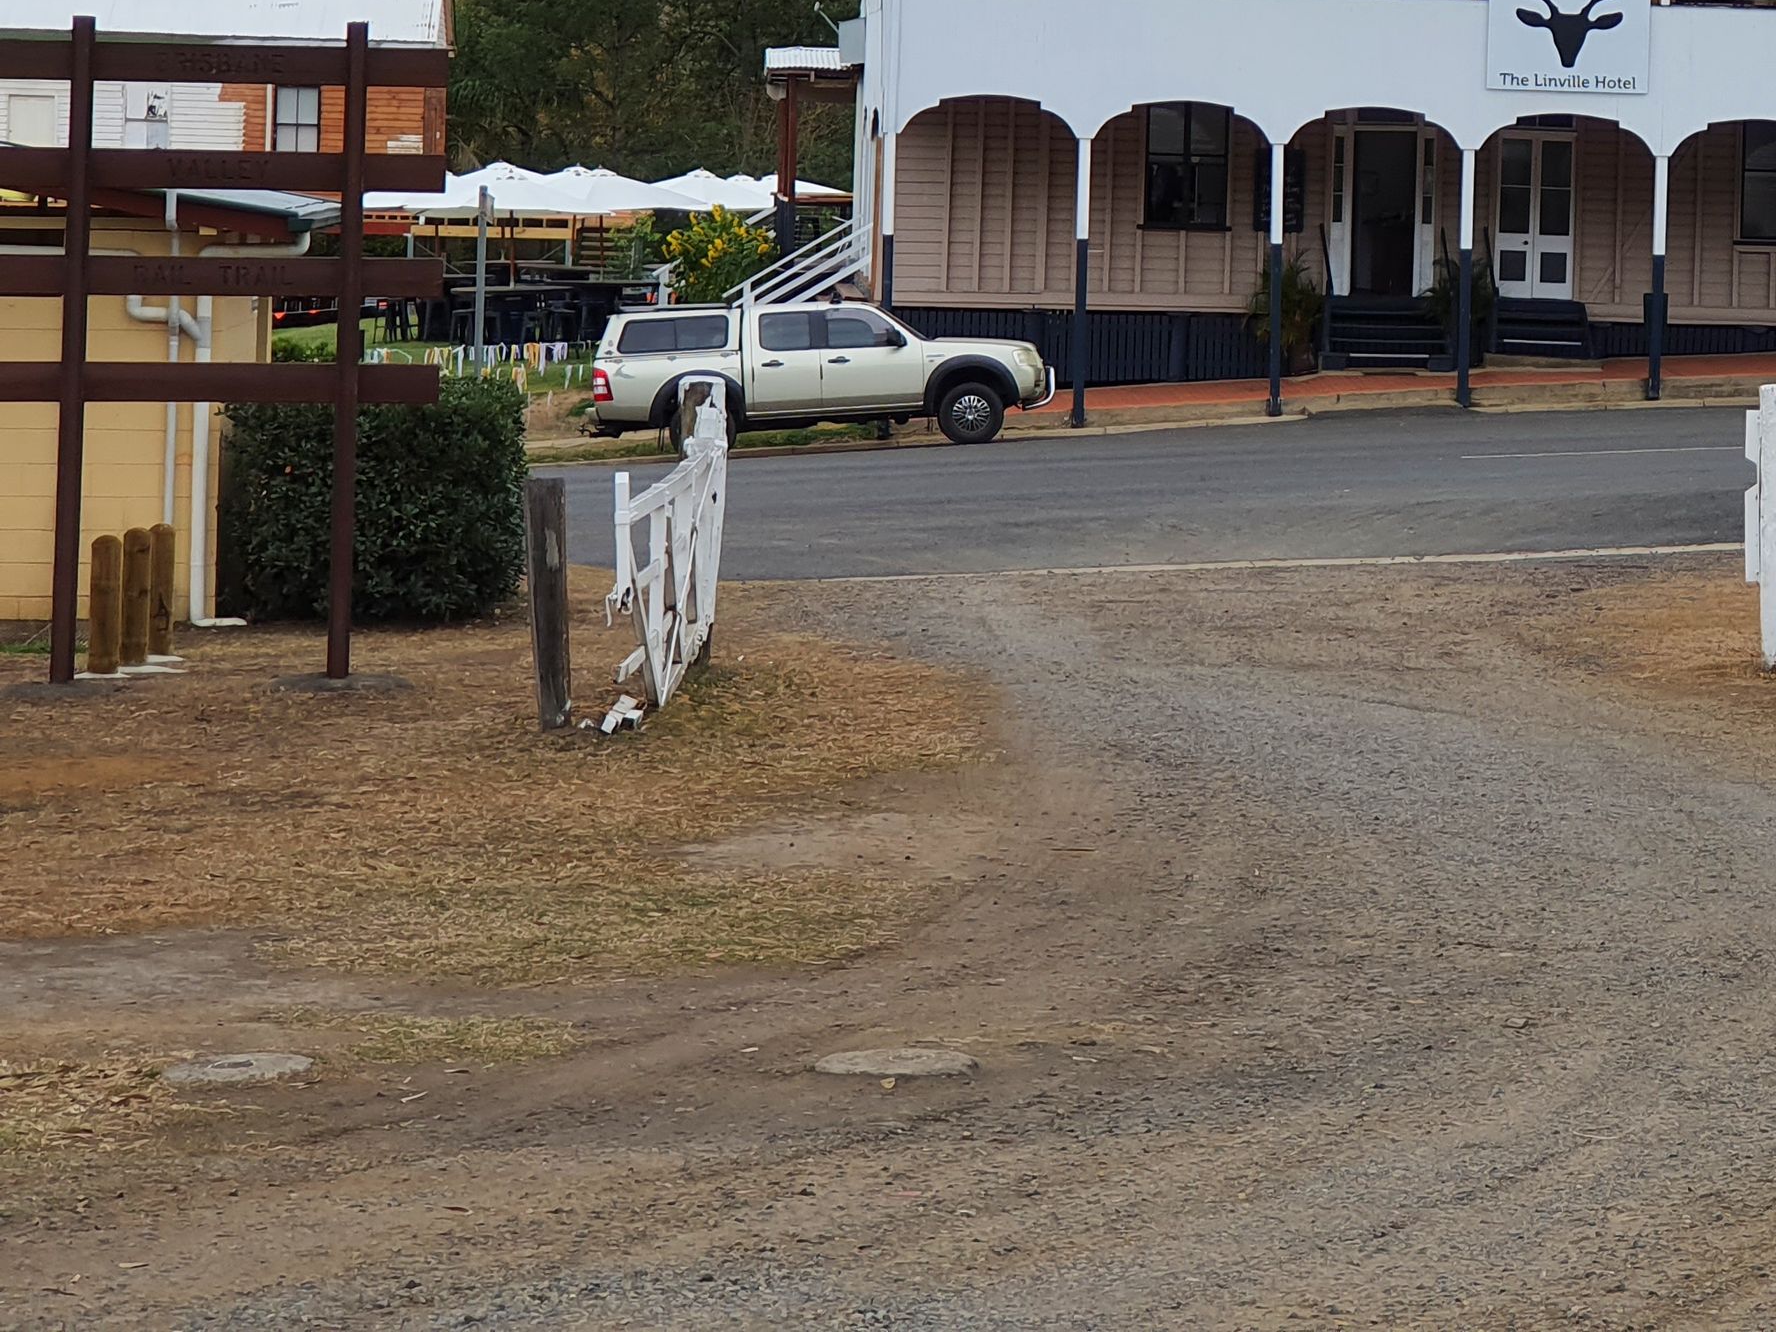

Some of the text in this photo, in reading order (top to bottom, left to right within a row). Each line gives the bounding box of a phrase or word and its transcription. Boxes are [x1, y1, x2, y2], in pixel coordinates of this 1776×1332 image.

[1499, 72, 1636, 90] The Linville Hotel
[167, 157, 268, 180] VALLEY
[133, 264, 294, 286] RAIL TRAIL
